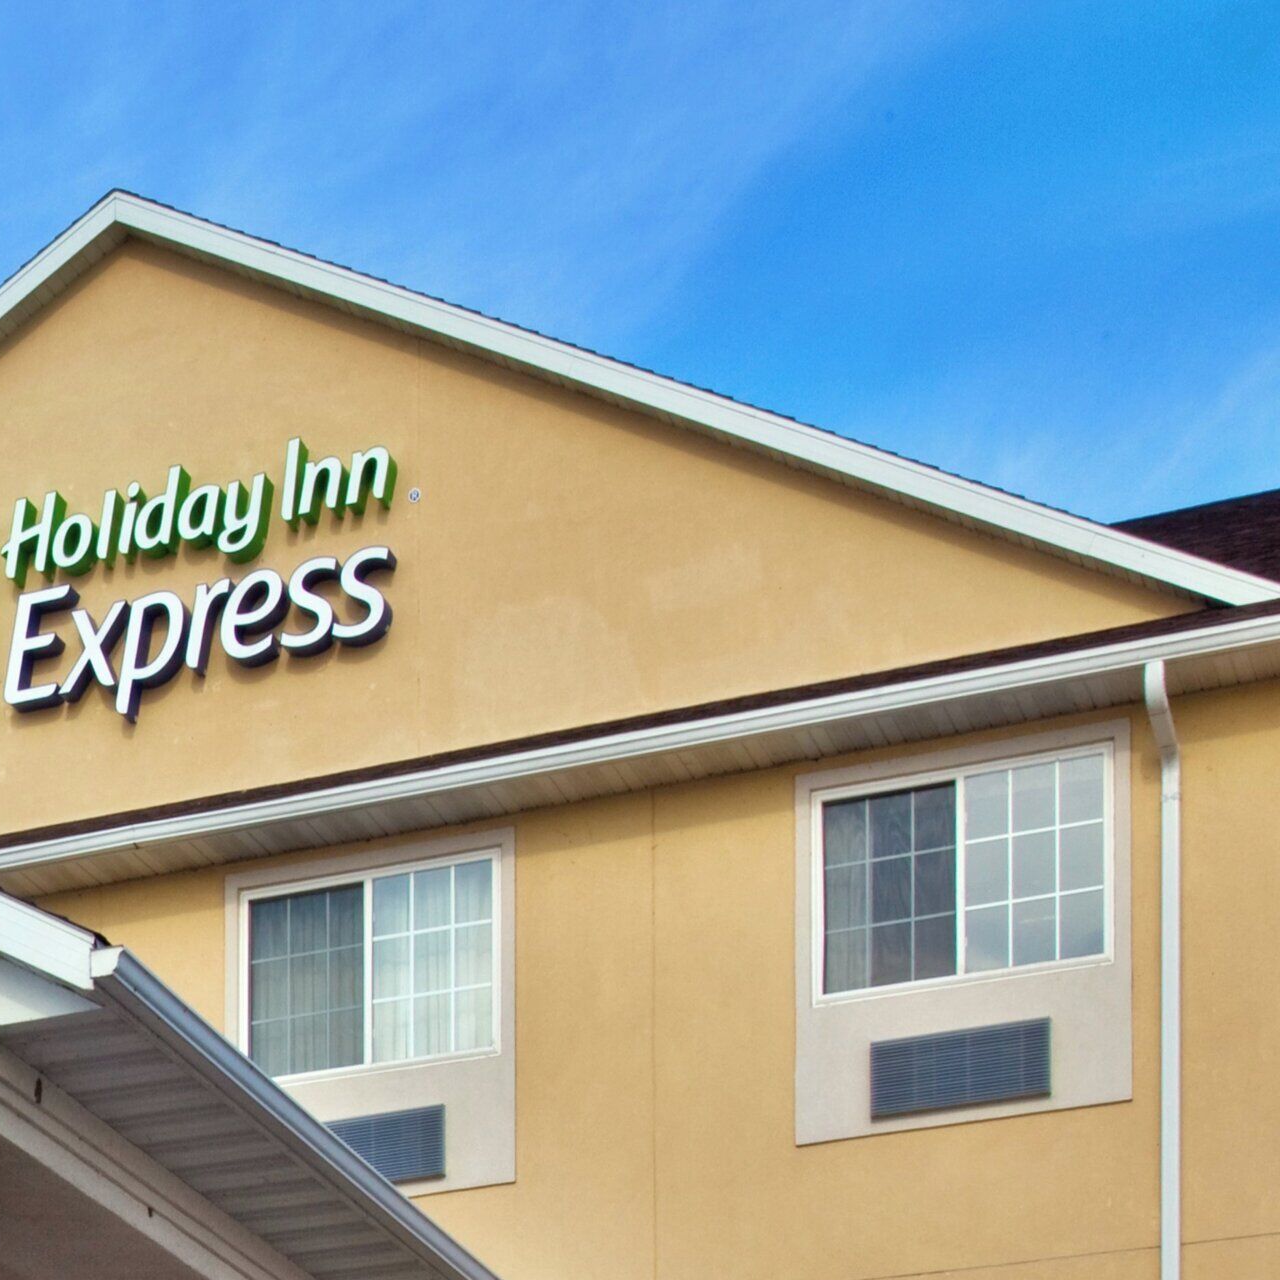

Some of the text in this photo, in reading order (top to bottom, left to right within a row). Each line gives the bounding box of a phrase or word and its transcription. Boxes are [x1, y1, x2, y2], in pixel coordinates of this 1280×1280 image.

[1, 437, 390, 580] Holiday Inn
[4, 546, 390, 715] Express
